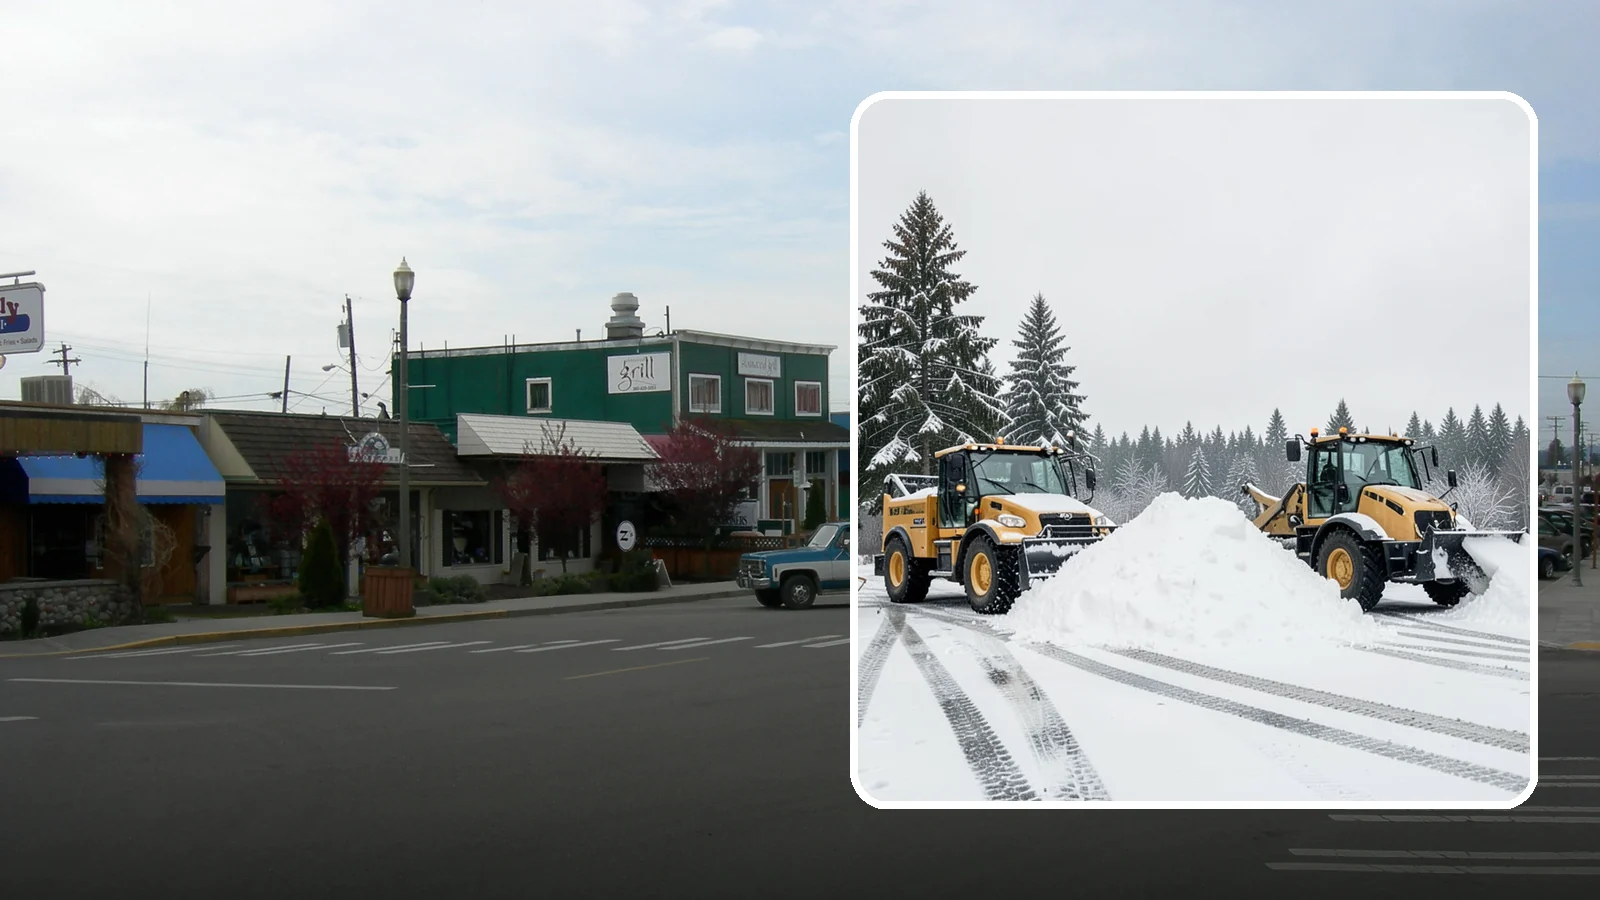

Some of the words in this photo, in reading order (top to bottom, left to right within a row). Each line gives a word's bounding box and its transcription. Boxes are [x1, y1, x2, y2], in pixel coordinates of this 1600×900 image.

[4, 338, 16, 346] Fries
[20, 337, 38, 345] Salads
[617, 356, 655, 392] grill
